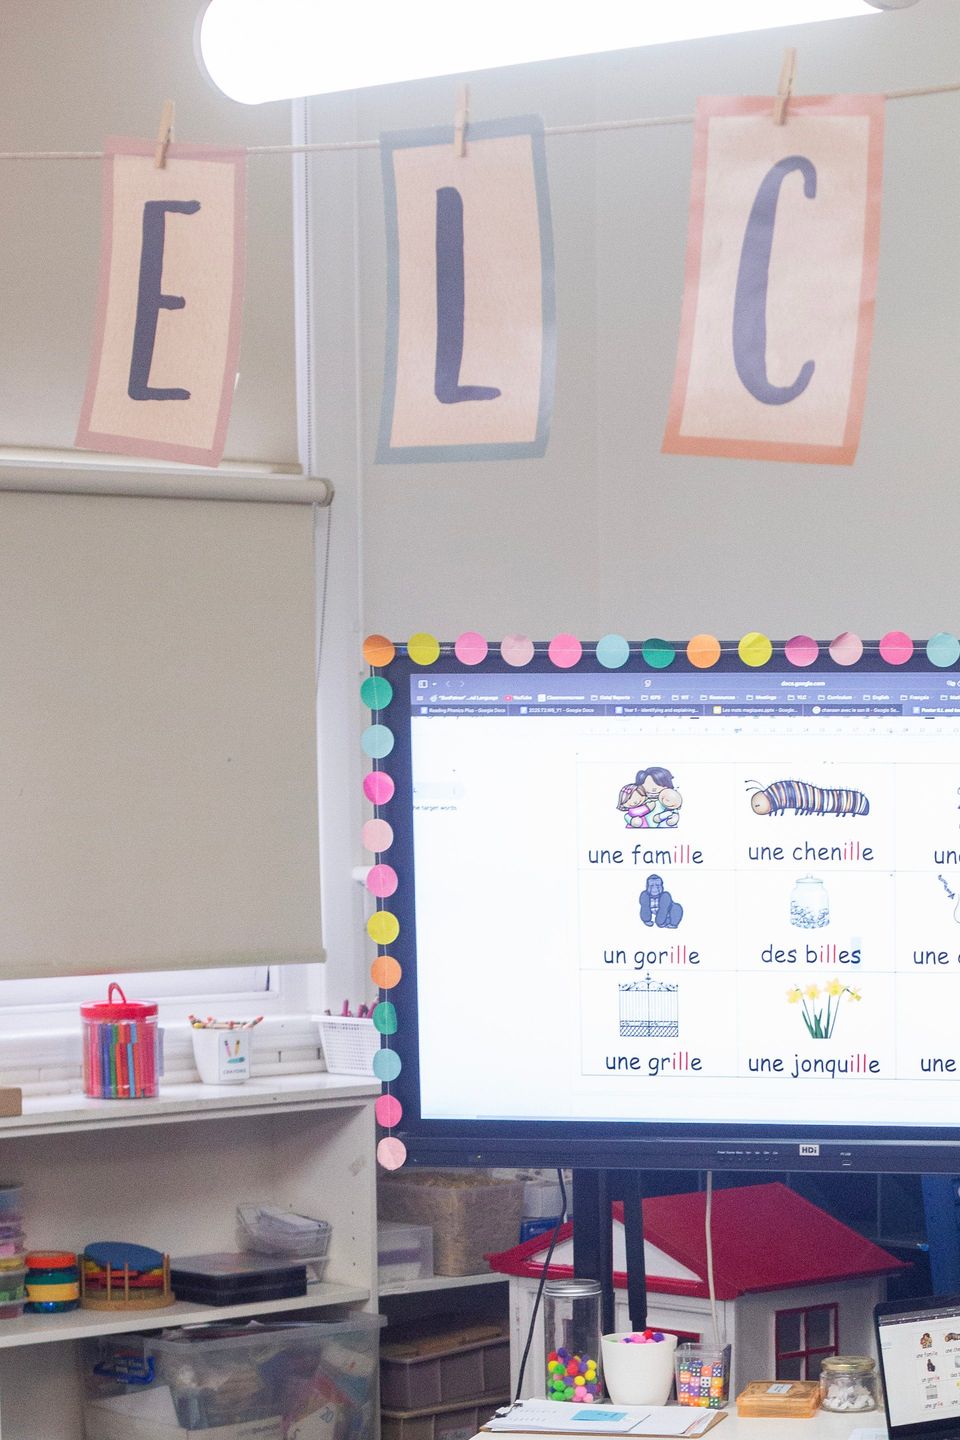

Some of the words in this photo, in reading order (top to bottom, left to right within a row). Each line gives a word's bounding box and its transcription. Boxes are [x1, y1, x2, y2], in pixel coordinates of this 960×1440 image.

[732, 154, 818, 407] C
[127, 199, 202, 402] E
[435, 186, 502, 405] L
[588, 850, 624, 864] une
[632, 844, 704, 865] famille
[749, 846, 785, 860] une
[792, 841, 874, 861] chenille
[604, 950, 626, 964] un
[634, 945, 700, 970] gorille
[761, 944, 797, 964] des
[806, 944, 861, 964] billes
[913, 950, 949, 965] une
[605, 1056, 641, 1071] une
[648, 1051, 702, 1076] grille
[749, 1057, 784, 1072] une
[791, 1053, 880, 1079] jonquille
[921, 1058, 956, 1072] une
